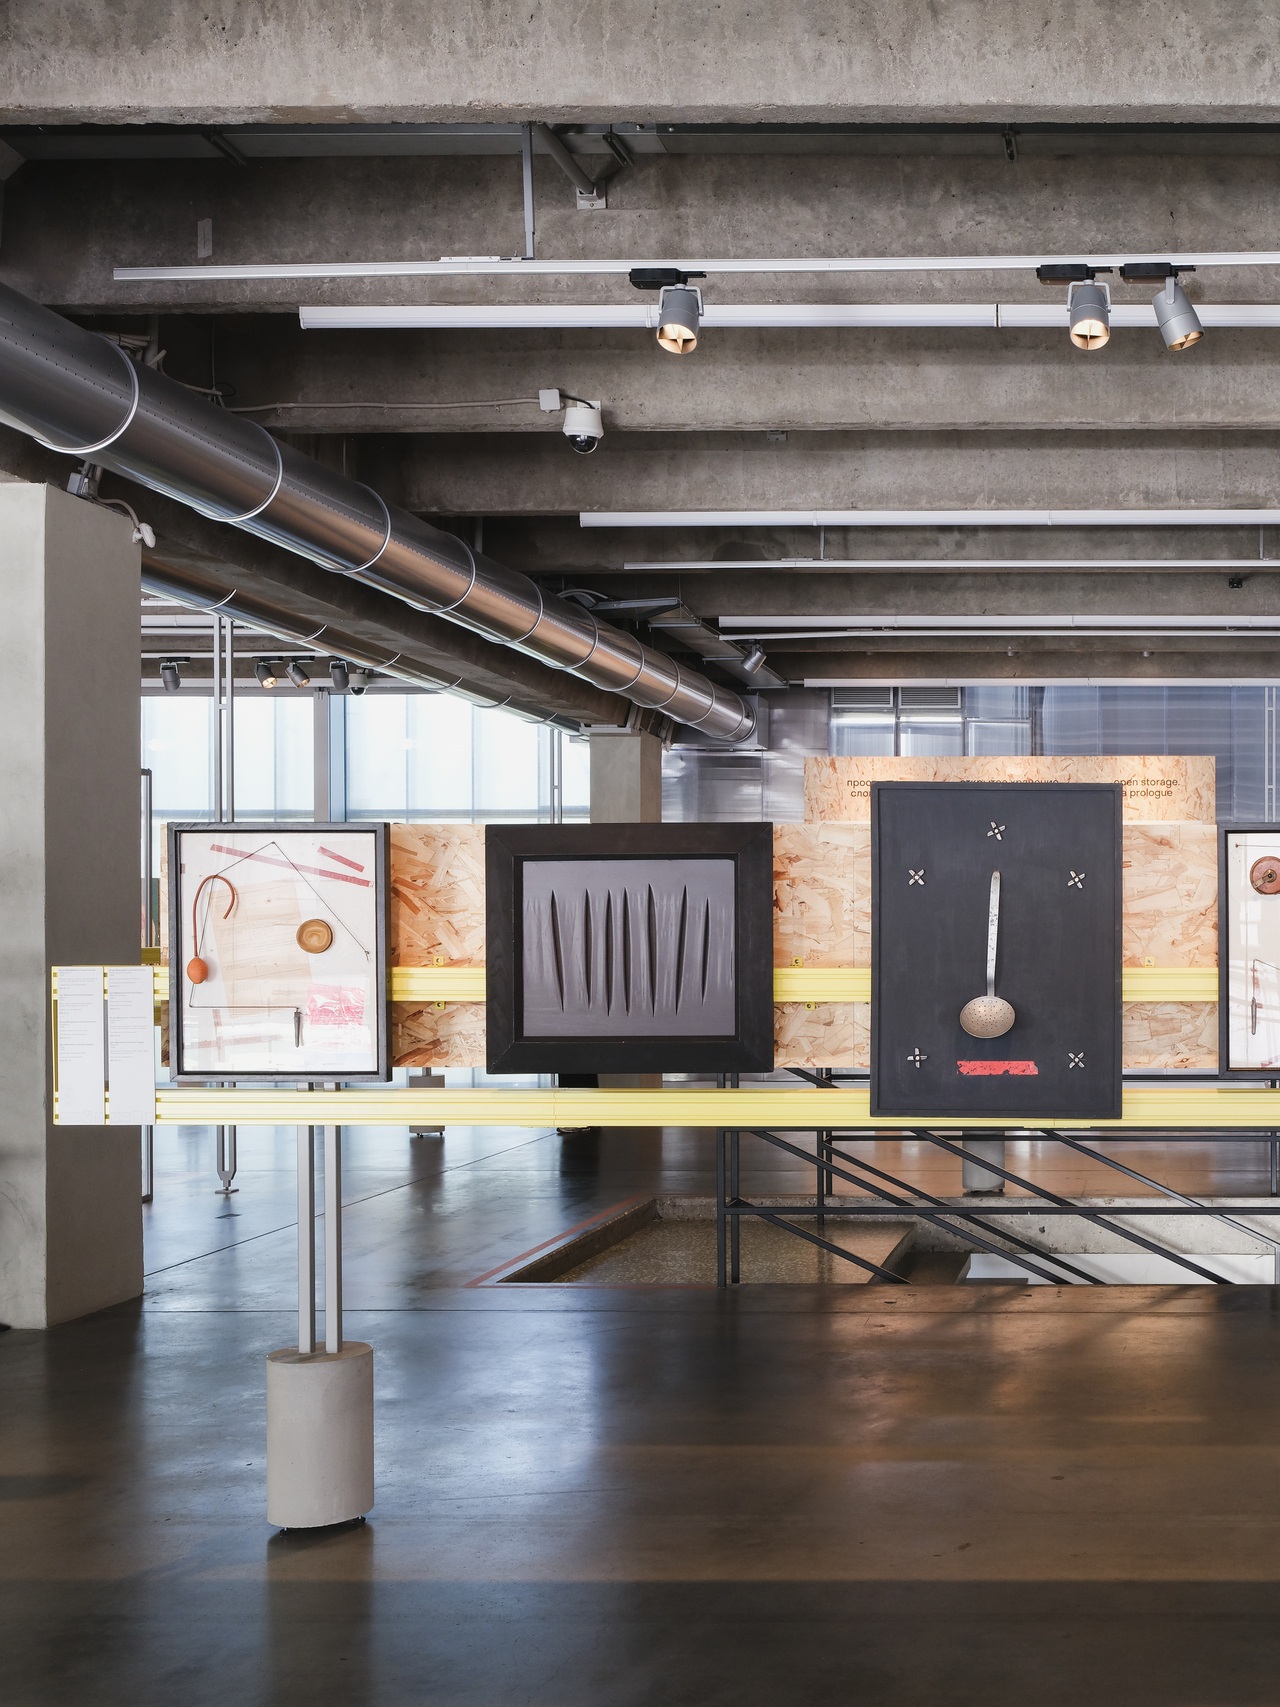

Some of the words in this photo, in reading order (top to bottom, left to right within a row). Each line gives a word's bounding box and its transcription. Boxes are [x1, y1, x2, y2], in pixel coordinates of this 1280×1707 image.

[847, 780, 871, 789] прос
[1141, 779, 1180, 788] storage.
[1130, 788, 1172, 799] prologue
